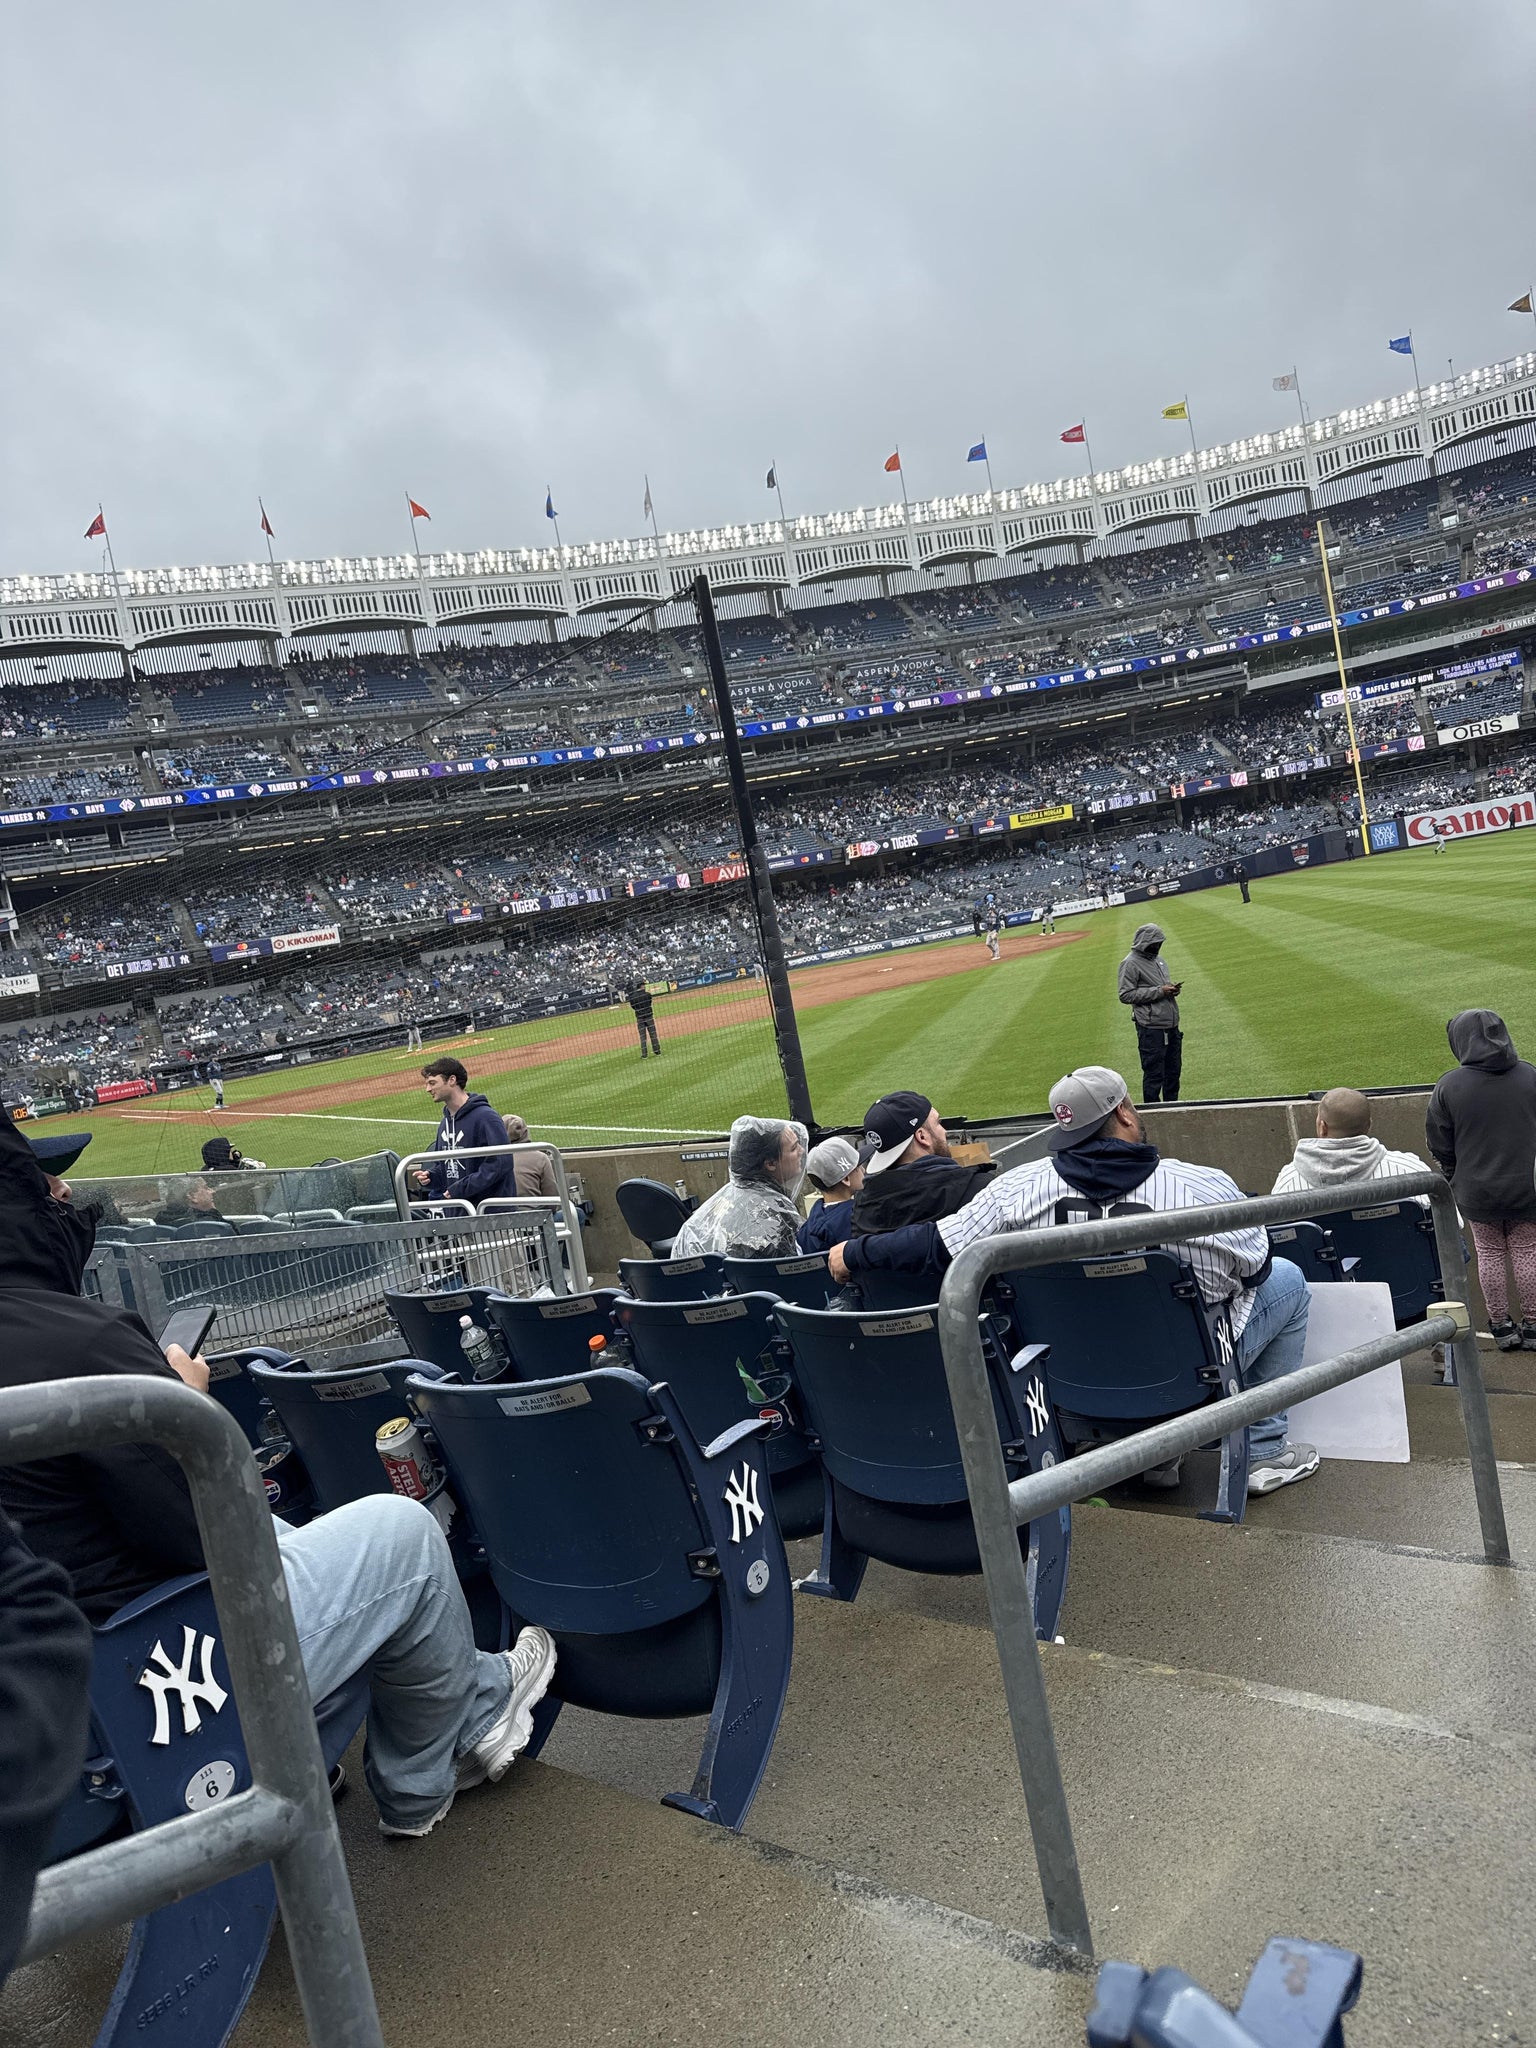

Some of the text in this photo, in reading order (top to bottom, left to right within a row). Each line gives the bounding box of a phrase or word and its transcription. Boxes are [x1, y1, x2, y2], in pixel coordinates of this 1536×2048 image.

[1486, 578, 1504, 588] RAYS
[1374, 607, 1390, 617] RAYS
[1420, 593, 1447, 605] YANKEES
[1480, 624, 1506, 636] Audi
[857, 659, 936, 678] ASPEN VODKA
[730, 678, 812, 697] ASPEN VODKA
[1366, 684, 1390, 694] RAFFLE
[1418, 673, 1434, 682] NOW
[1453, 720, 1502, 740] ORIS
[502, 757, 528, 766] YANKEES
[343, 775, 360, 784] RAYS
[392, 767, 419, 778] YANKEES
[1265, 766, 1280, 779] DET
[216, 788, 234, 798] RAYS
[267, 782, 298, 792] YANKEES
[85, 804, 105, 814] RAYS
[140, 796, 172, 808] YANKEES
[1092, 801, 1106, 814] DET
[0, 812, 34, 824] YANKEES
[1408, 800, 1534, 840] Canon
[1372, 831, 1396, 840] YORK
[1374, 825, 1392, 834] NEW
[890, 834, 918, 850] TIGERS
[1376, 837, 1395, 846] LIFE
[510, 898, 540, 914] TIGERS
[288, 932, 336, 946] KIKKOMAN
[106, 963, 124, 978] DET
[49, 1100, 66, 1109] Sprin
[837, 1156, 852, 1172] NY
[1216, 1315, 1234, 1366] NY
[530, 1396, 548, 1404] ALERT
[557, 1396, 575, 1406] BALLS
[1026, 1375, 1050, 1438] NY
[388, 1466, 406, 1496] ARTO
[398, 1464, 419, 1498] STELL
[264, 1485, 278, 1496] PSI
[724, 1461, 764, 1543] NY
[756, 1574, 763, 1586] 5
[139, 1625, 228, 1745] NY
[200, 1767, 213, 1780] 111
[206, 1780, 219, 1798] 6
